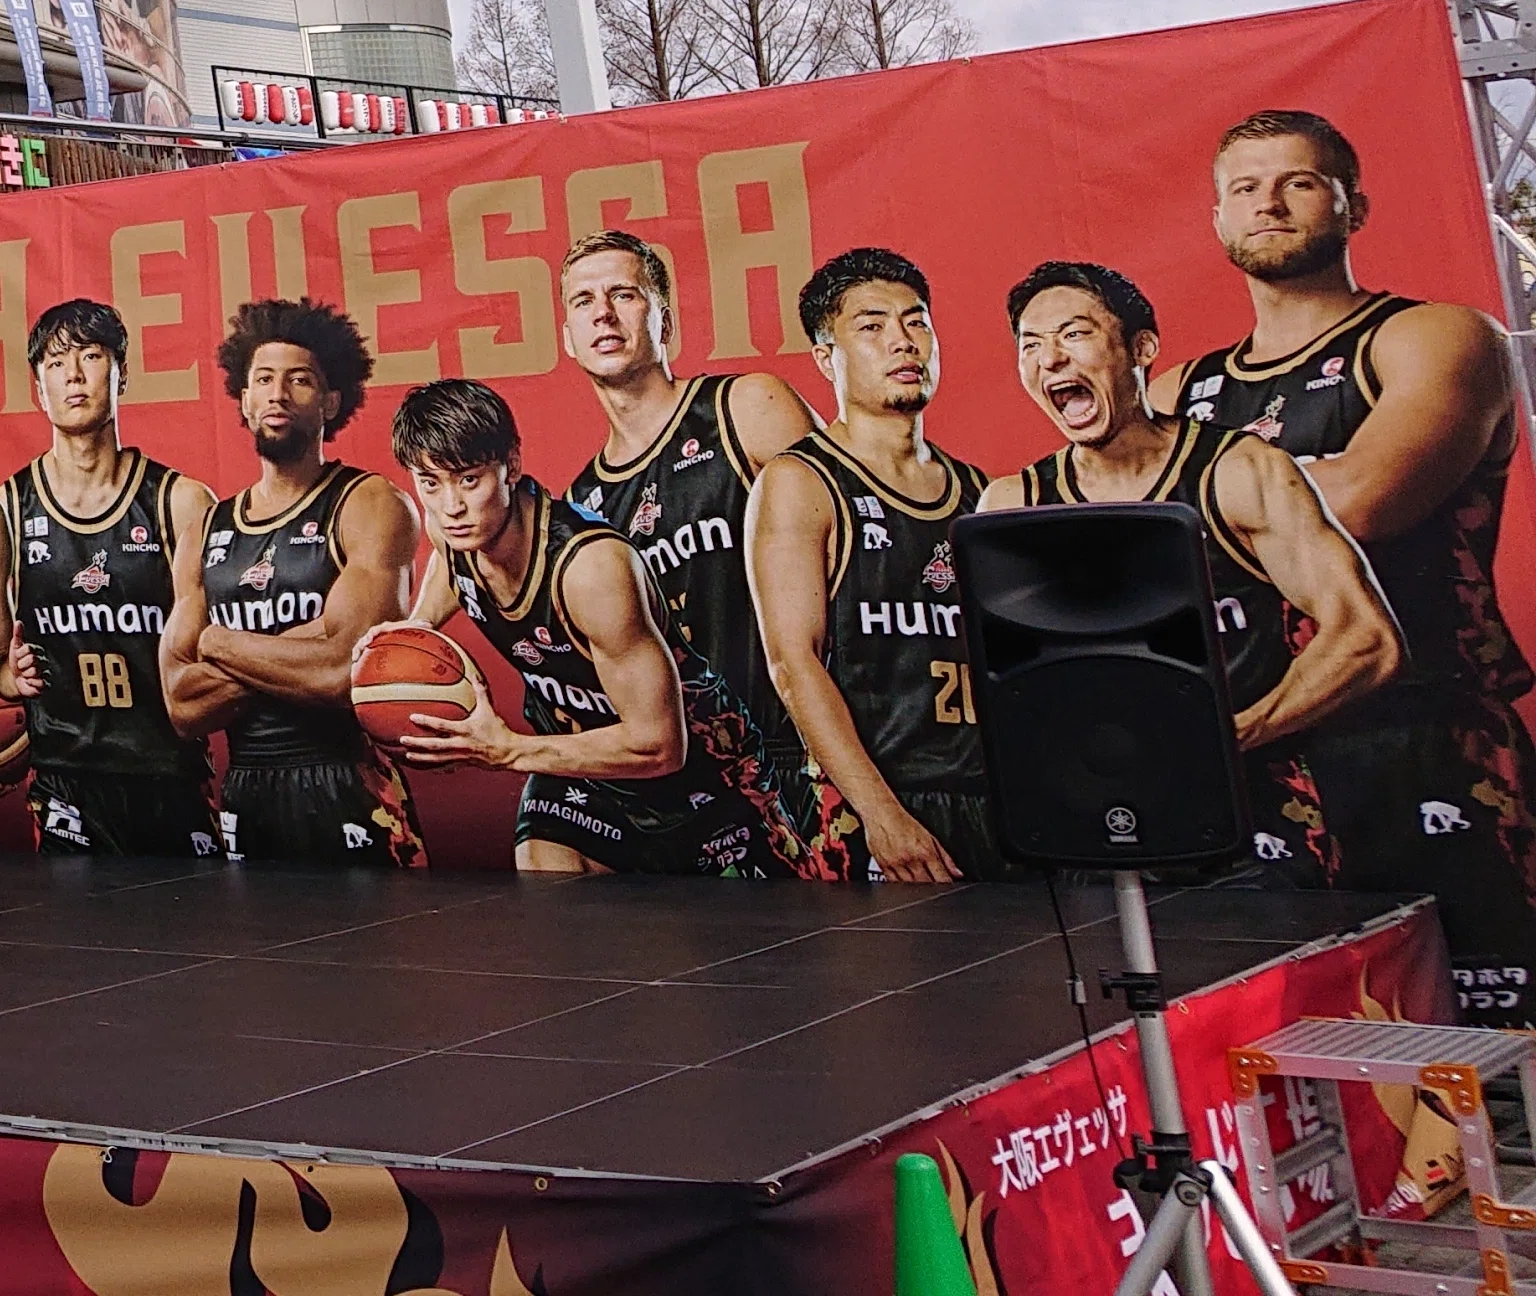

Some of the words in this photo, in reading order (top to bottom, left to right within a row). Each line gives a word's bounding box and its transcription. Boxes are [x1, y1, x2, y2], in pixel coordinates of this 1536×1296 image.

[672, 449, 715, 473] KINCHO
[121, 542, 161, 553] KINCHO
[289, 534, 326, 546] KINCHO
[642, 515, 734, 576] man
[34, 602, 164, 635] Human
[860, 601, 962, 638] Hum
[78, 652, 134, 708] 88
[524, 670, 618, 716] man
[523, 798, 623, 842] YANAGIMOTO
[990, 1083, 1129, 1199] 大阪エヴェッサ
